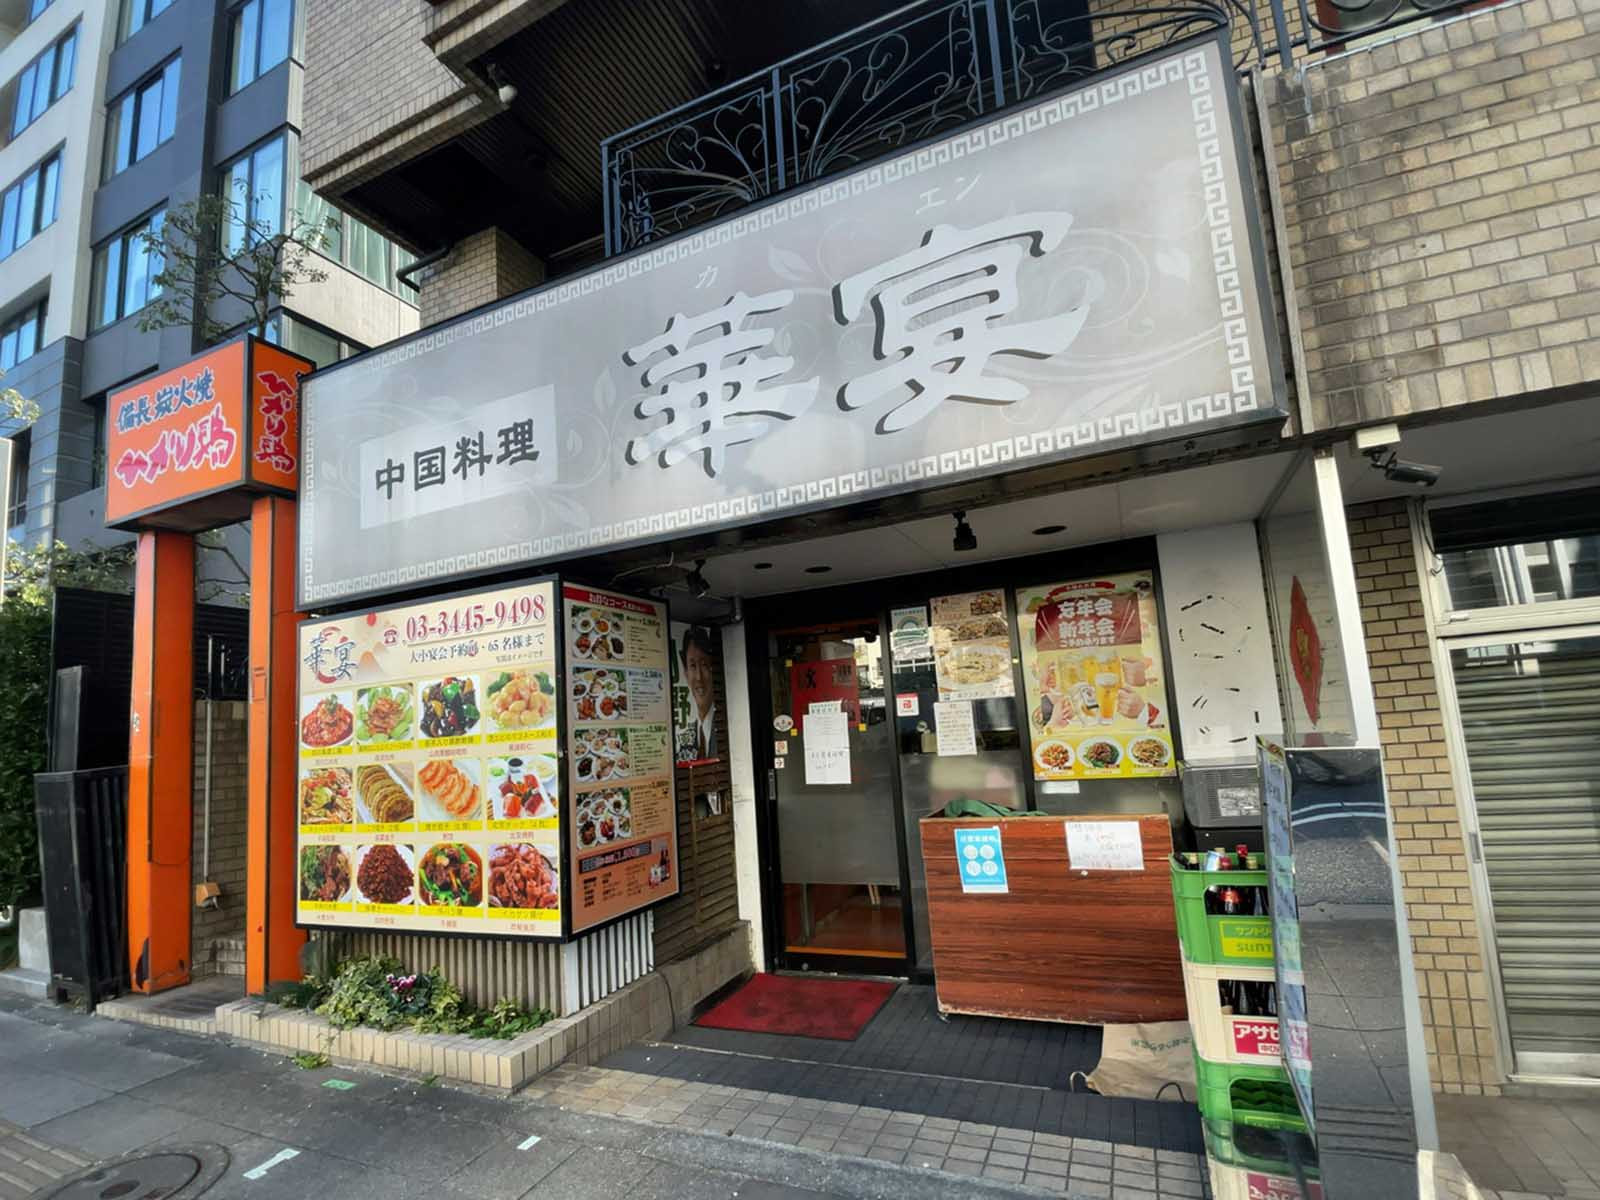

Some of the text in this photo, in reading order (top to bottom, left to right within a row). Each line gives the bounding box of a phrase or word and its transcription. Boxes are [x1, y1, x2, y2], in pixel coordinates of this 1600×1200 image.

[916, 173, 982, 215] エン
[695, 265, 719, 289] カ
[622, 210, 1091, 479] 華宴
[375, 418, 540, 500] 中国料理
[406, 594, 546, 640] 03-3445-9498
[1058, 598, 1113, 619] 忘年会
[1059, 618, 1116, 639] 新年会
